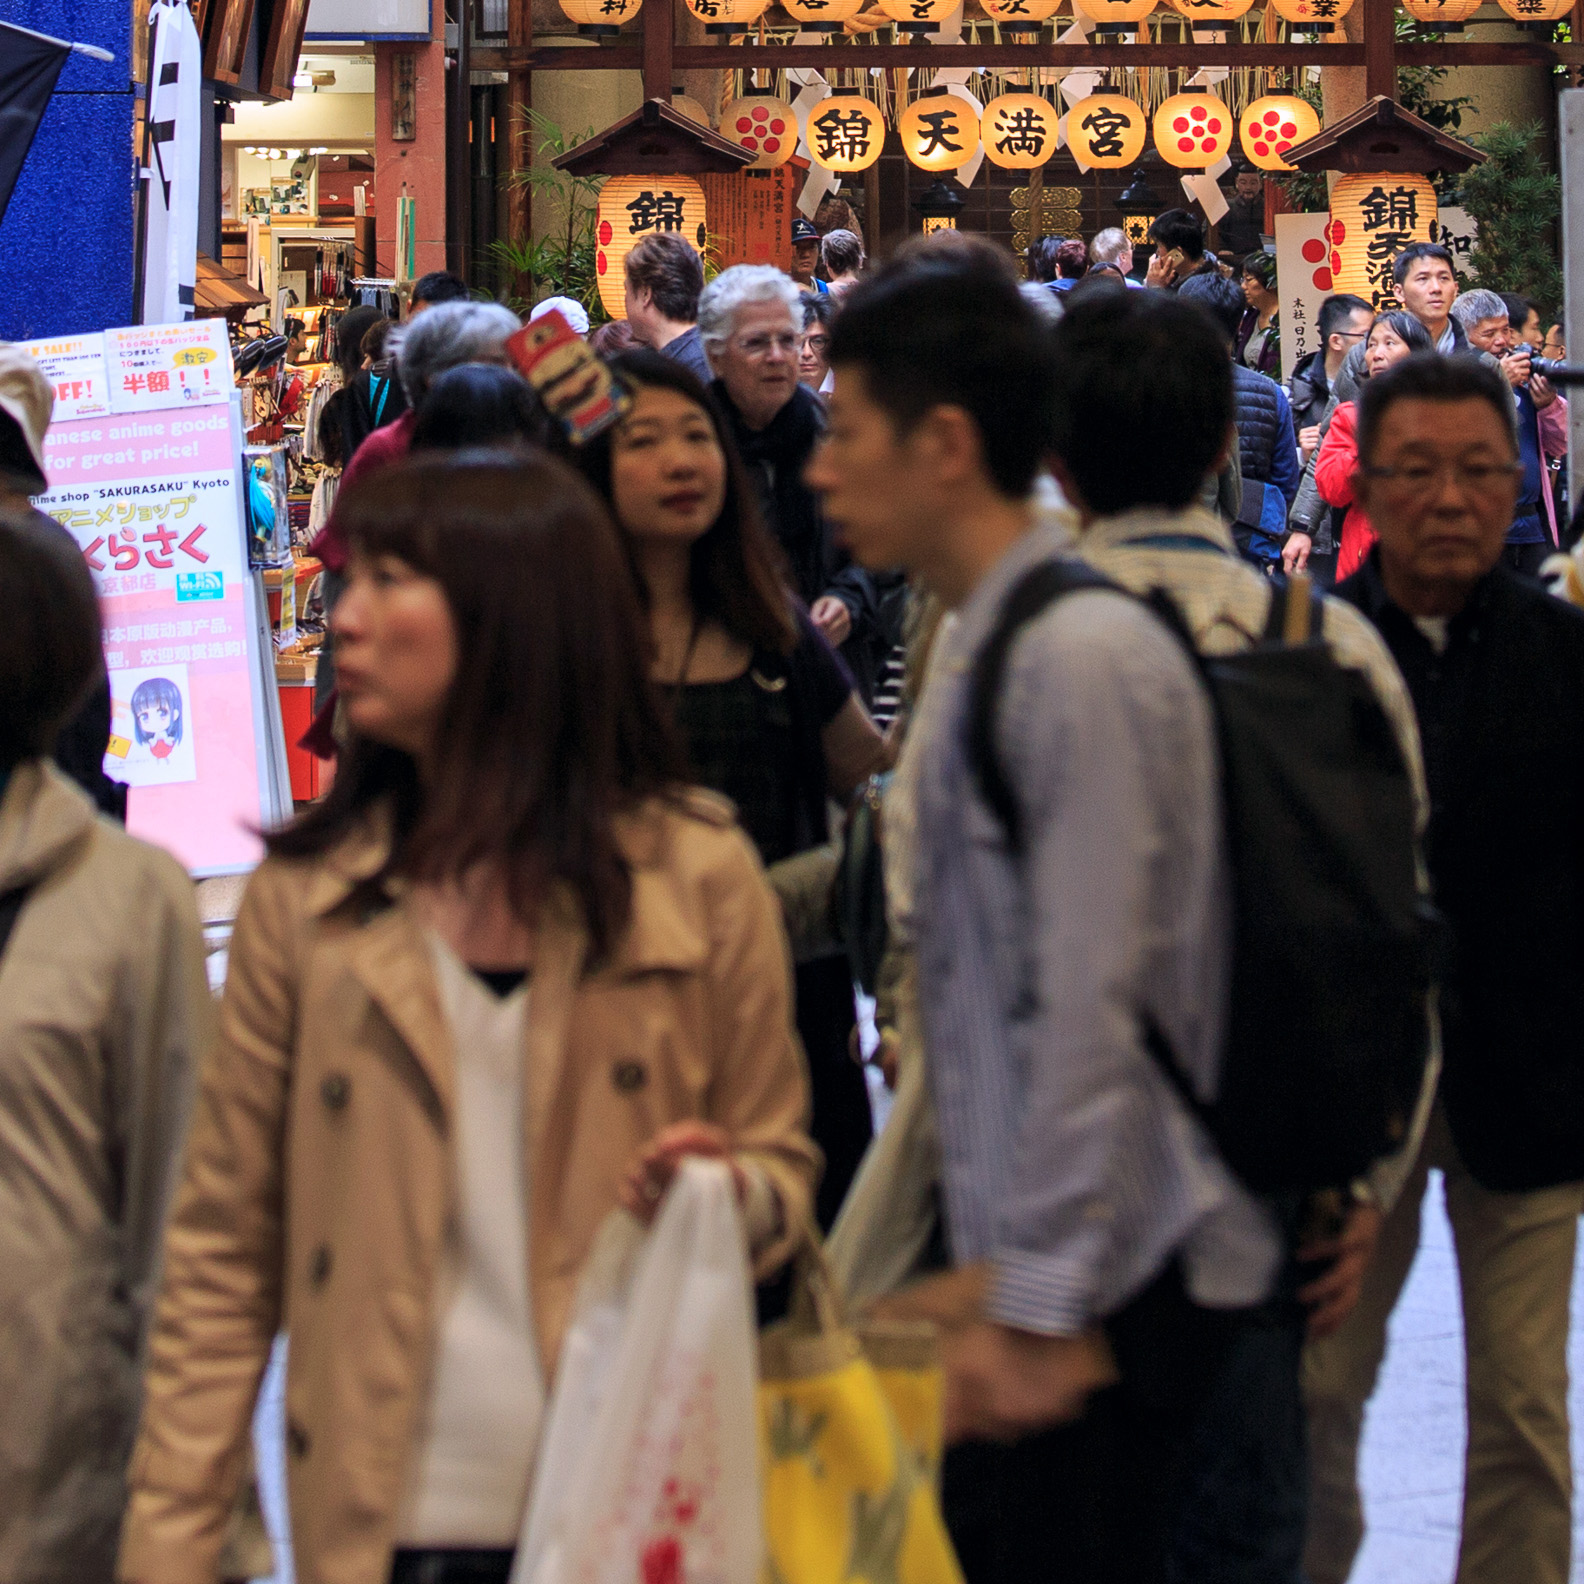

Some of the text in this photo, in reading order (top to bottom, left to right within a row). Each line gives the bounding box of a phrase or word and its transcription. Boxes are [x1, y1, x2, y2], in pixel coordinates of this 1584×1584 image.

[815, 108, 872, 163] 錦
[917, 110, 964, 156] 天
[994, 108, 1047, 158] 満
[1081, 106, 1131, 158] 宮
[44, 414, 229, 447] anese anime goods
[43, 439, 200, 471] for great price!
[48, 494, 198, 527] アニメショップ
[61, 491, 90, 504] shop
[193, 478, 231, 491] Kyoto
